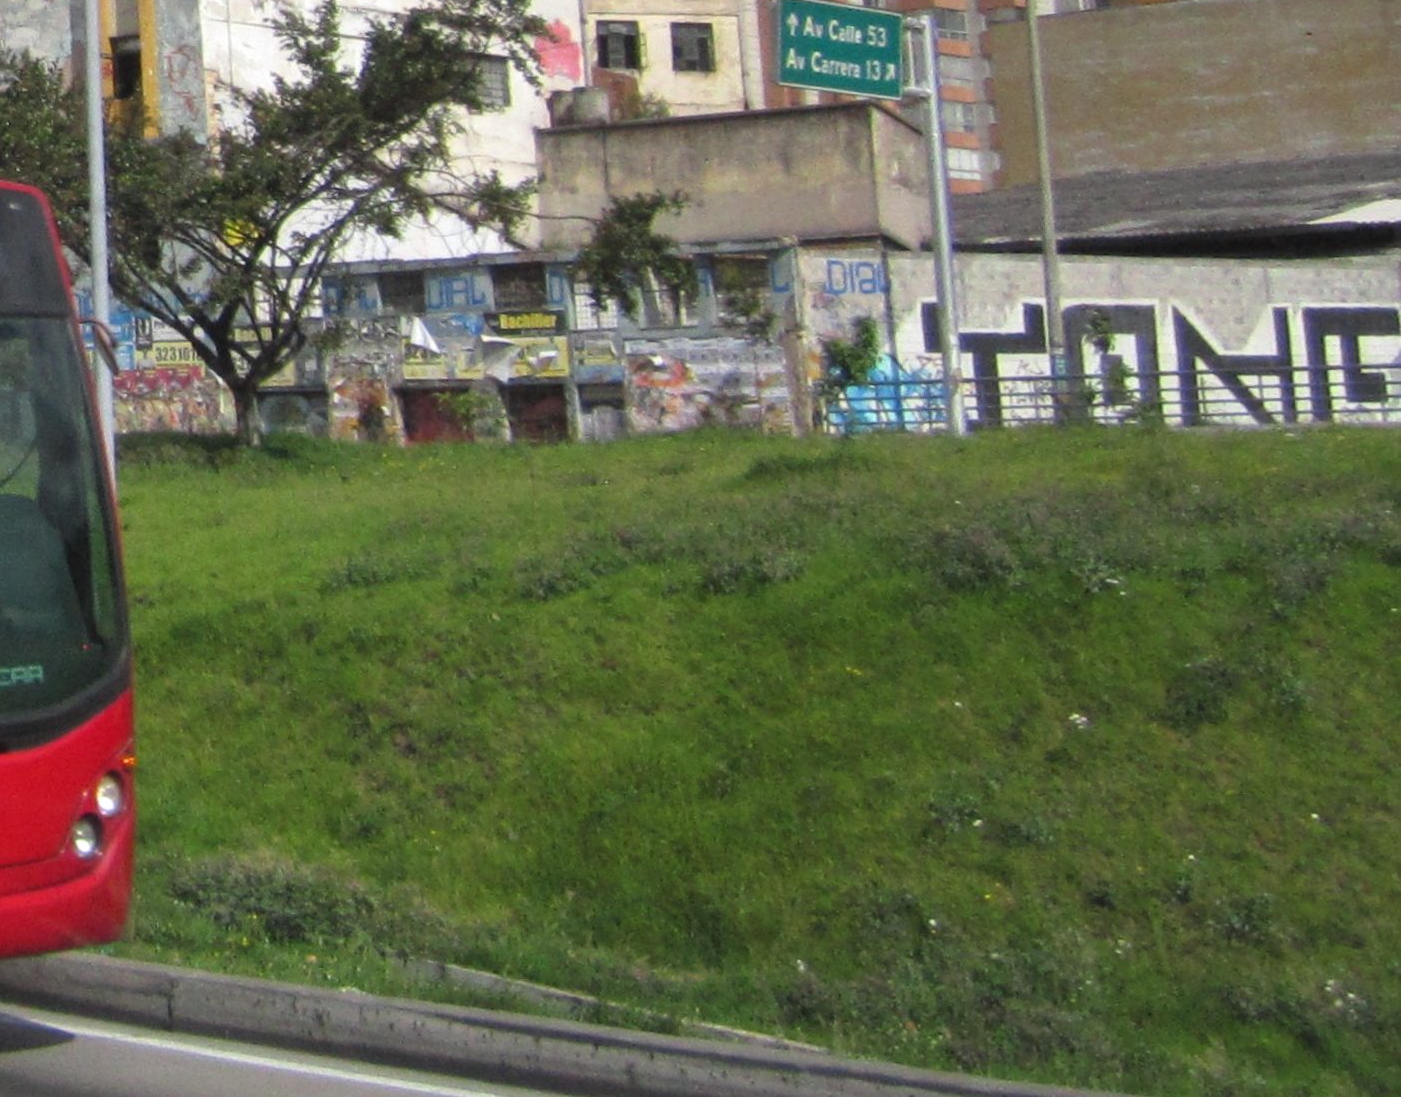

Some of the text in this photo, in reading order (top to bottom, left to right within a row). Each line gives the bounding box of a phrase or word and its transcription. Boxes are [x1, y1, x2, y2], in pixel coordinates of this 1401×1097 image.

[803, 15, 888, 48] Av Calle 53
[786, 48, 881, 81] Av Carrera 13
